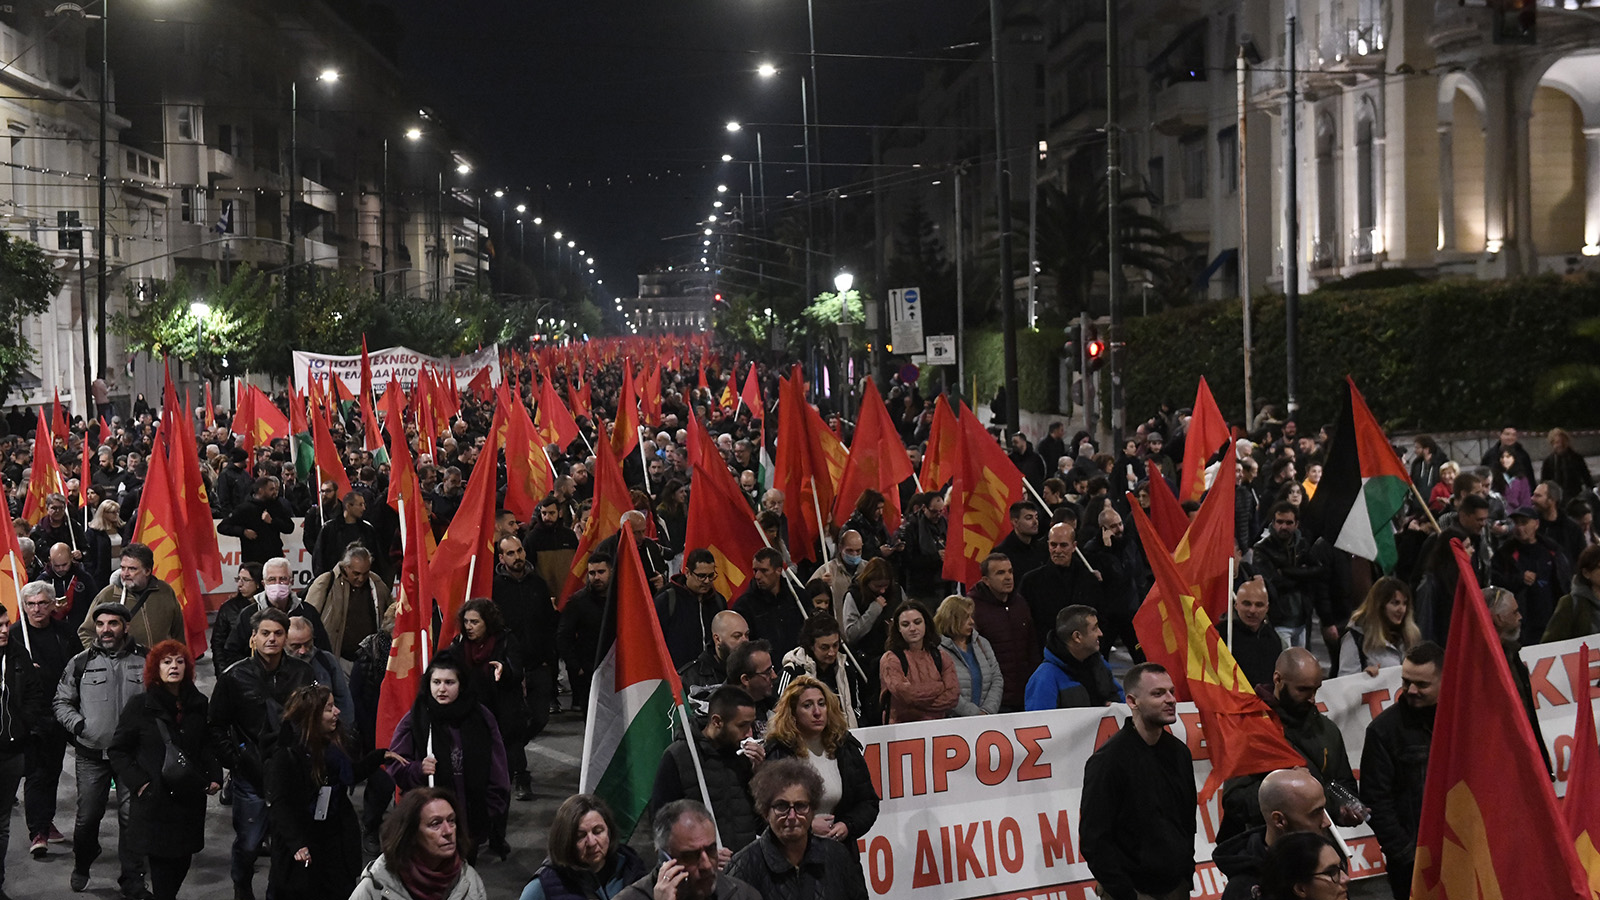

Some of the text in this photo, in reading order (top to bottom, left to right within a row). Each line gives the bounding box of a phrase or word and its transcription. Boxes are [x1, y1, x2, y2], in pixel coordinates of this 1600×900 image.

[308, 359, 325, 368] ΤΟ
[330, 354, 419, 368] ΠΟΛΤΕΧΝΕΙΟ
[394, 368, 417, 376] ΑΠΟ
[912, 816, 1023, 889] ΔΙΚΙΟ
